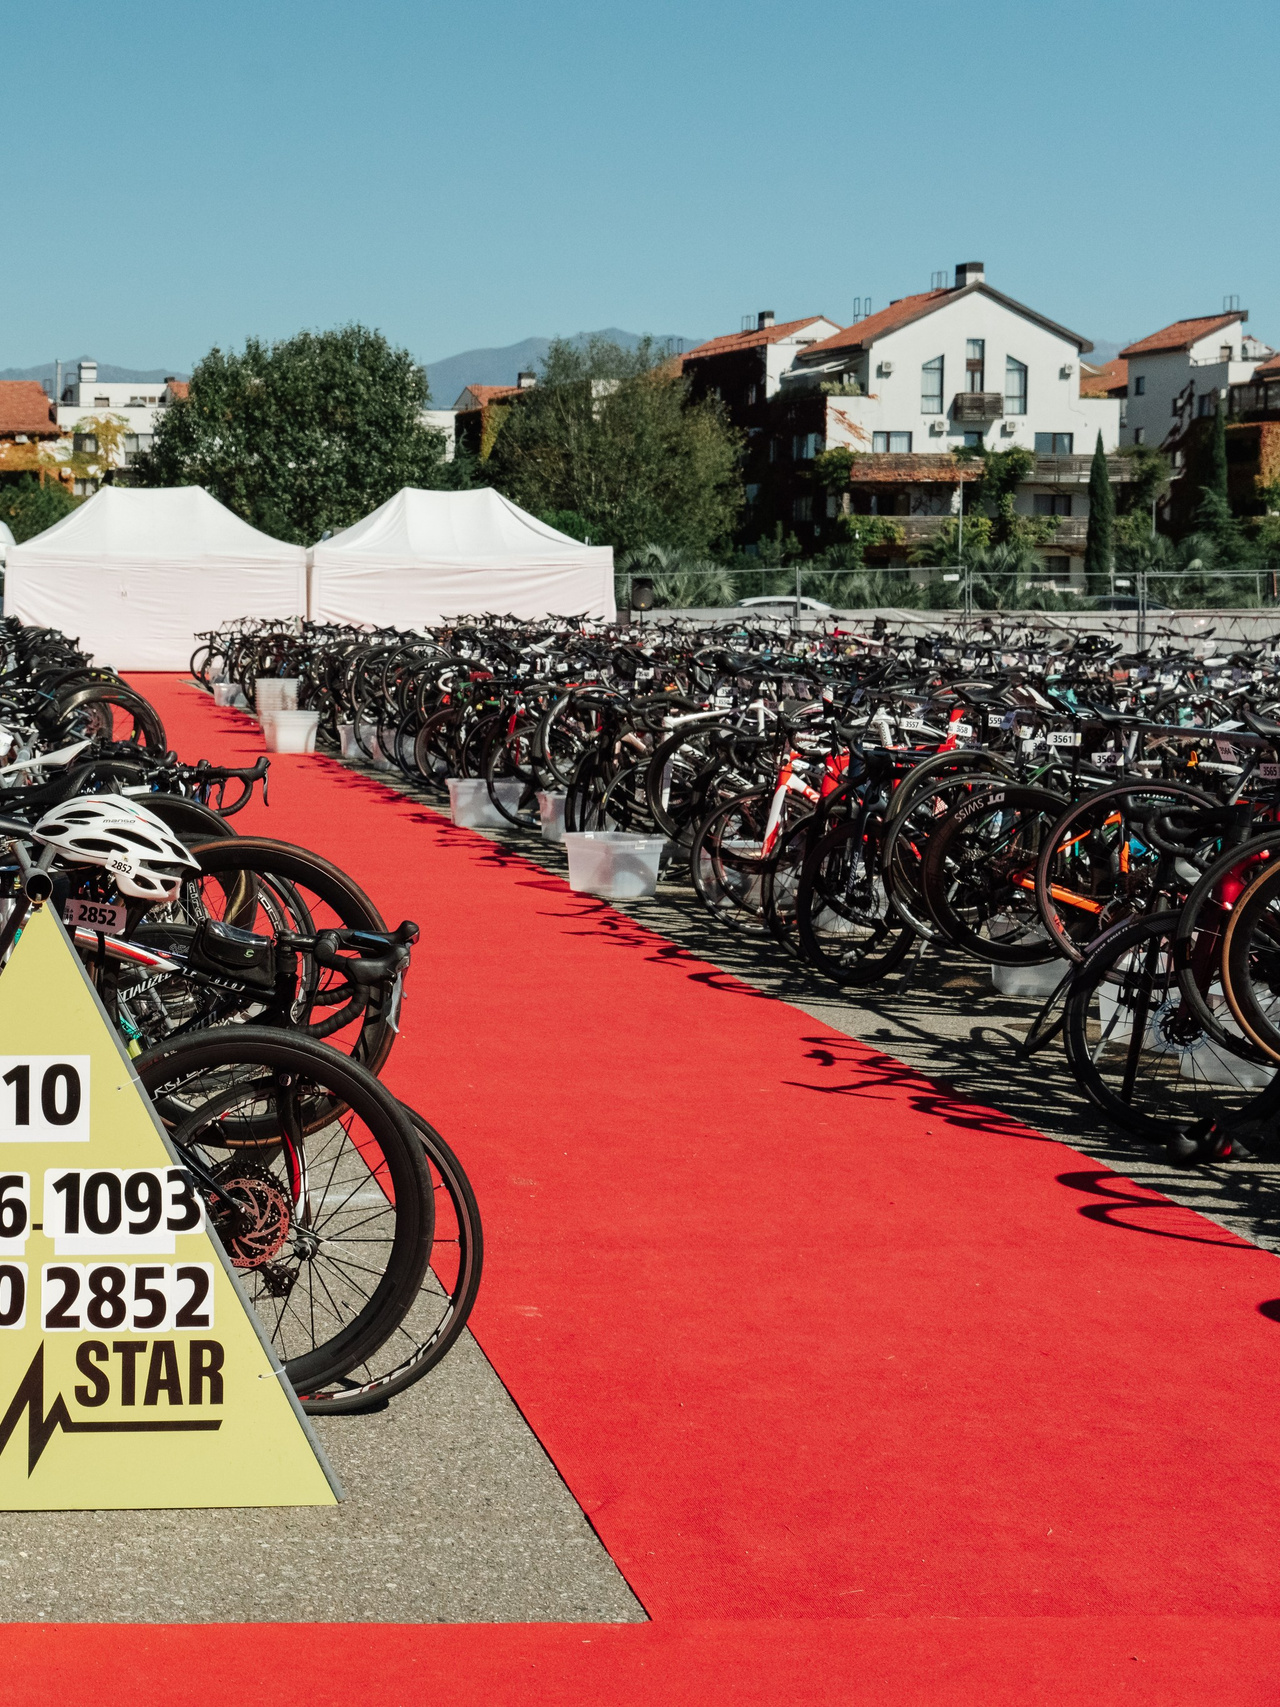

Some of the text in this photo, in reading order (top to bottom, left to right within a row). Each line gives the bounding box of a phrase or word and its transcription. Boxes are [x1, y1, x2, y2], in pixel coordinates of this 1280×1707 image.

[905, 721, 919, 729] 3557
[1053, 734, 1072, 743] 3561
[1096, 754, 1115, 764] 3562
[1262, 766, 1276, 776] 3565
[954, 797, 985, 824] SWISS
[111, 859, 132, 875] 2852
[77, 905, 115, 926] 2852
[2, 1063, 81, 1126] 10
[52, 1171, 202, 1235] 1093
[44, 1265, 211, 1329] 2852
[74, 1339, 225, 1407] STAR
